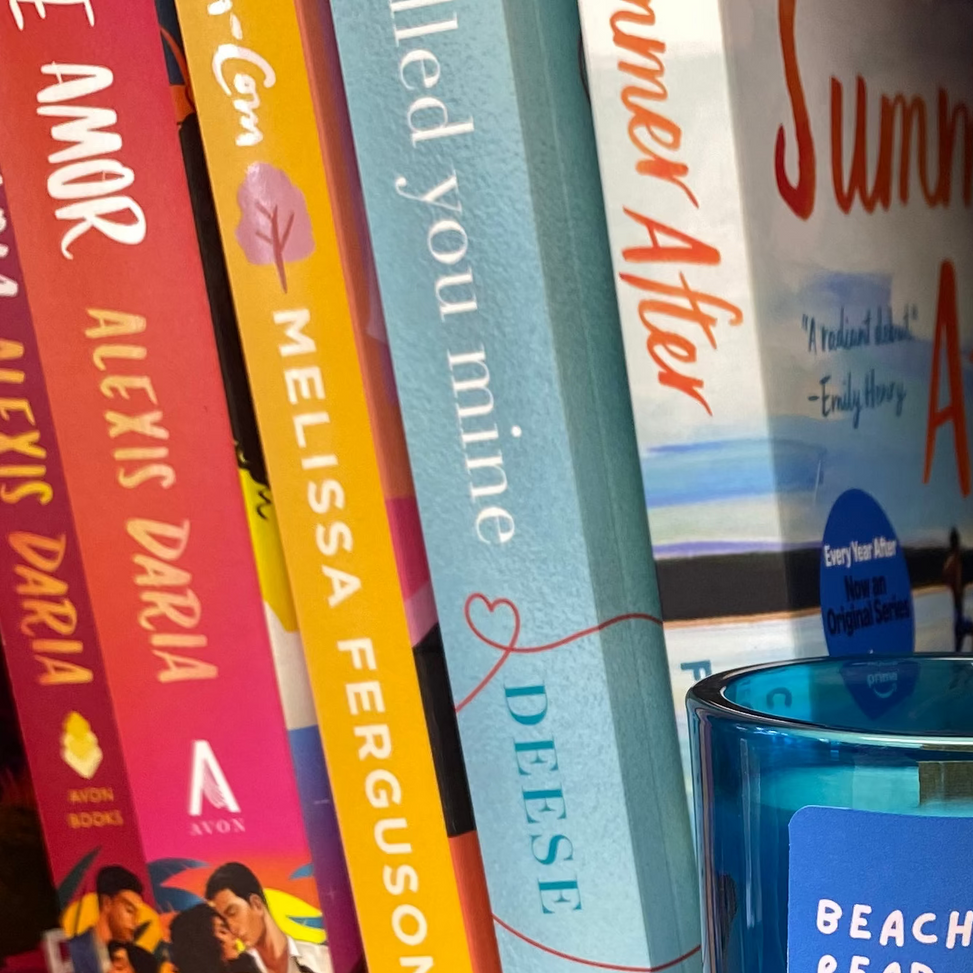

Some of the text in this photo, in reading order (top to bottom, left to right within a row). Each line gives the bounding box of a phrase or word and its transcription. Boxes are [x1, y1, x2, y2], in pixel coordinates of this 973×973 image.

[37, 61, 146, 260] AMOR
[395, 169, 478, 322] you
[447, 344, 522, 545] mine
[619, 205, 743, 416] After
[85, 307, 219, 684] ALEXIS DARIA
[272, 308, 362, 609] MELISSA
[7, 530, 95, 686] DARIA
[824, 535, 898, 569] Every Year After
[827, 598, 874, 637] Original
[844, 574, 888, 603] Now an
[69, 786, 115, 803] AVON
[69, 810, 124, 829] BOOKS
[189, 818, 246, 836] AVON
[504, 683, 583, 915] DEESE
